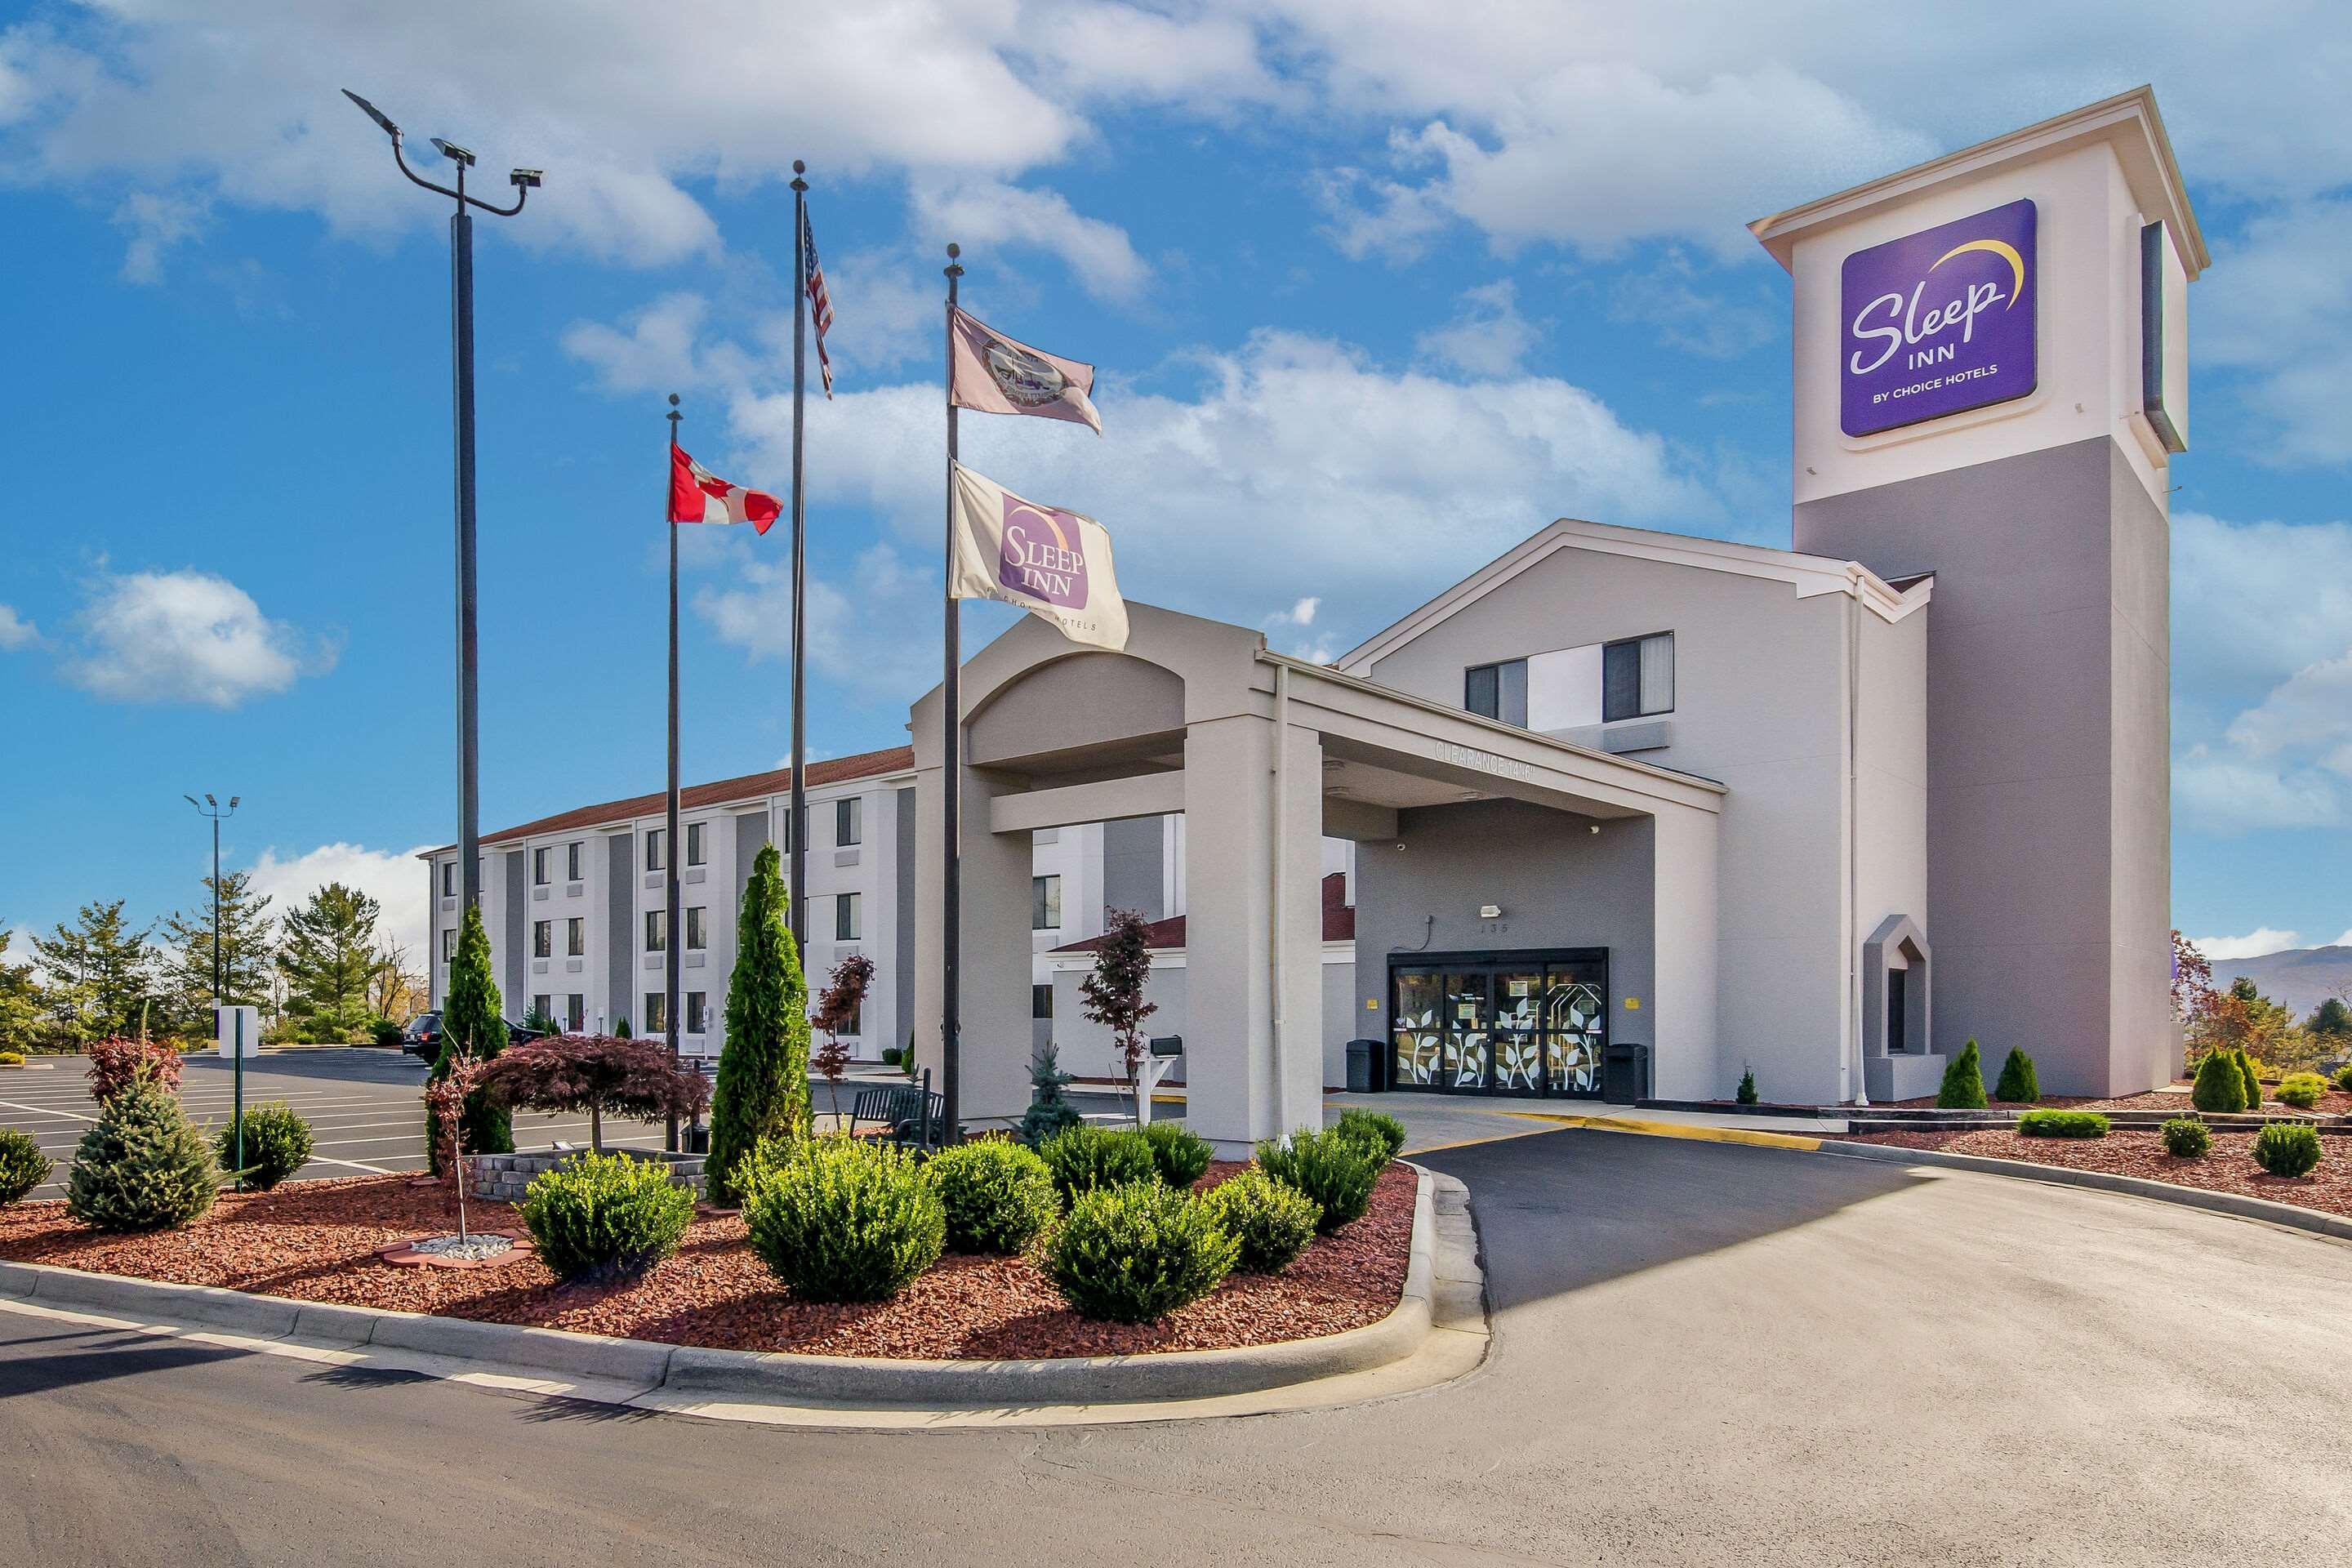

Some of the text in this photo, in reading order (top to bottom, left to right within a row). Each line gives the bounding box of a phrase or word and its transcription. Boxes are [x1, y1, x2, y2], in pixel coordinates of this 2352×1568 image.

[1850, 281, 2006, 375] Sleep
[1908, 343, 1955, 371] INN
[1873, 364, 1998, 404] BY CHOICE HOTELS
[1021, 567, 1074, 597] INN
[1435, 742, 1505, 775] CLEARANCE
